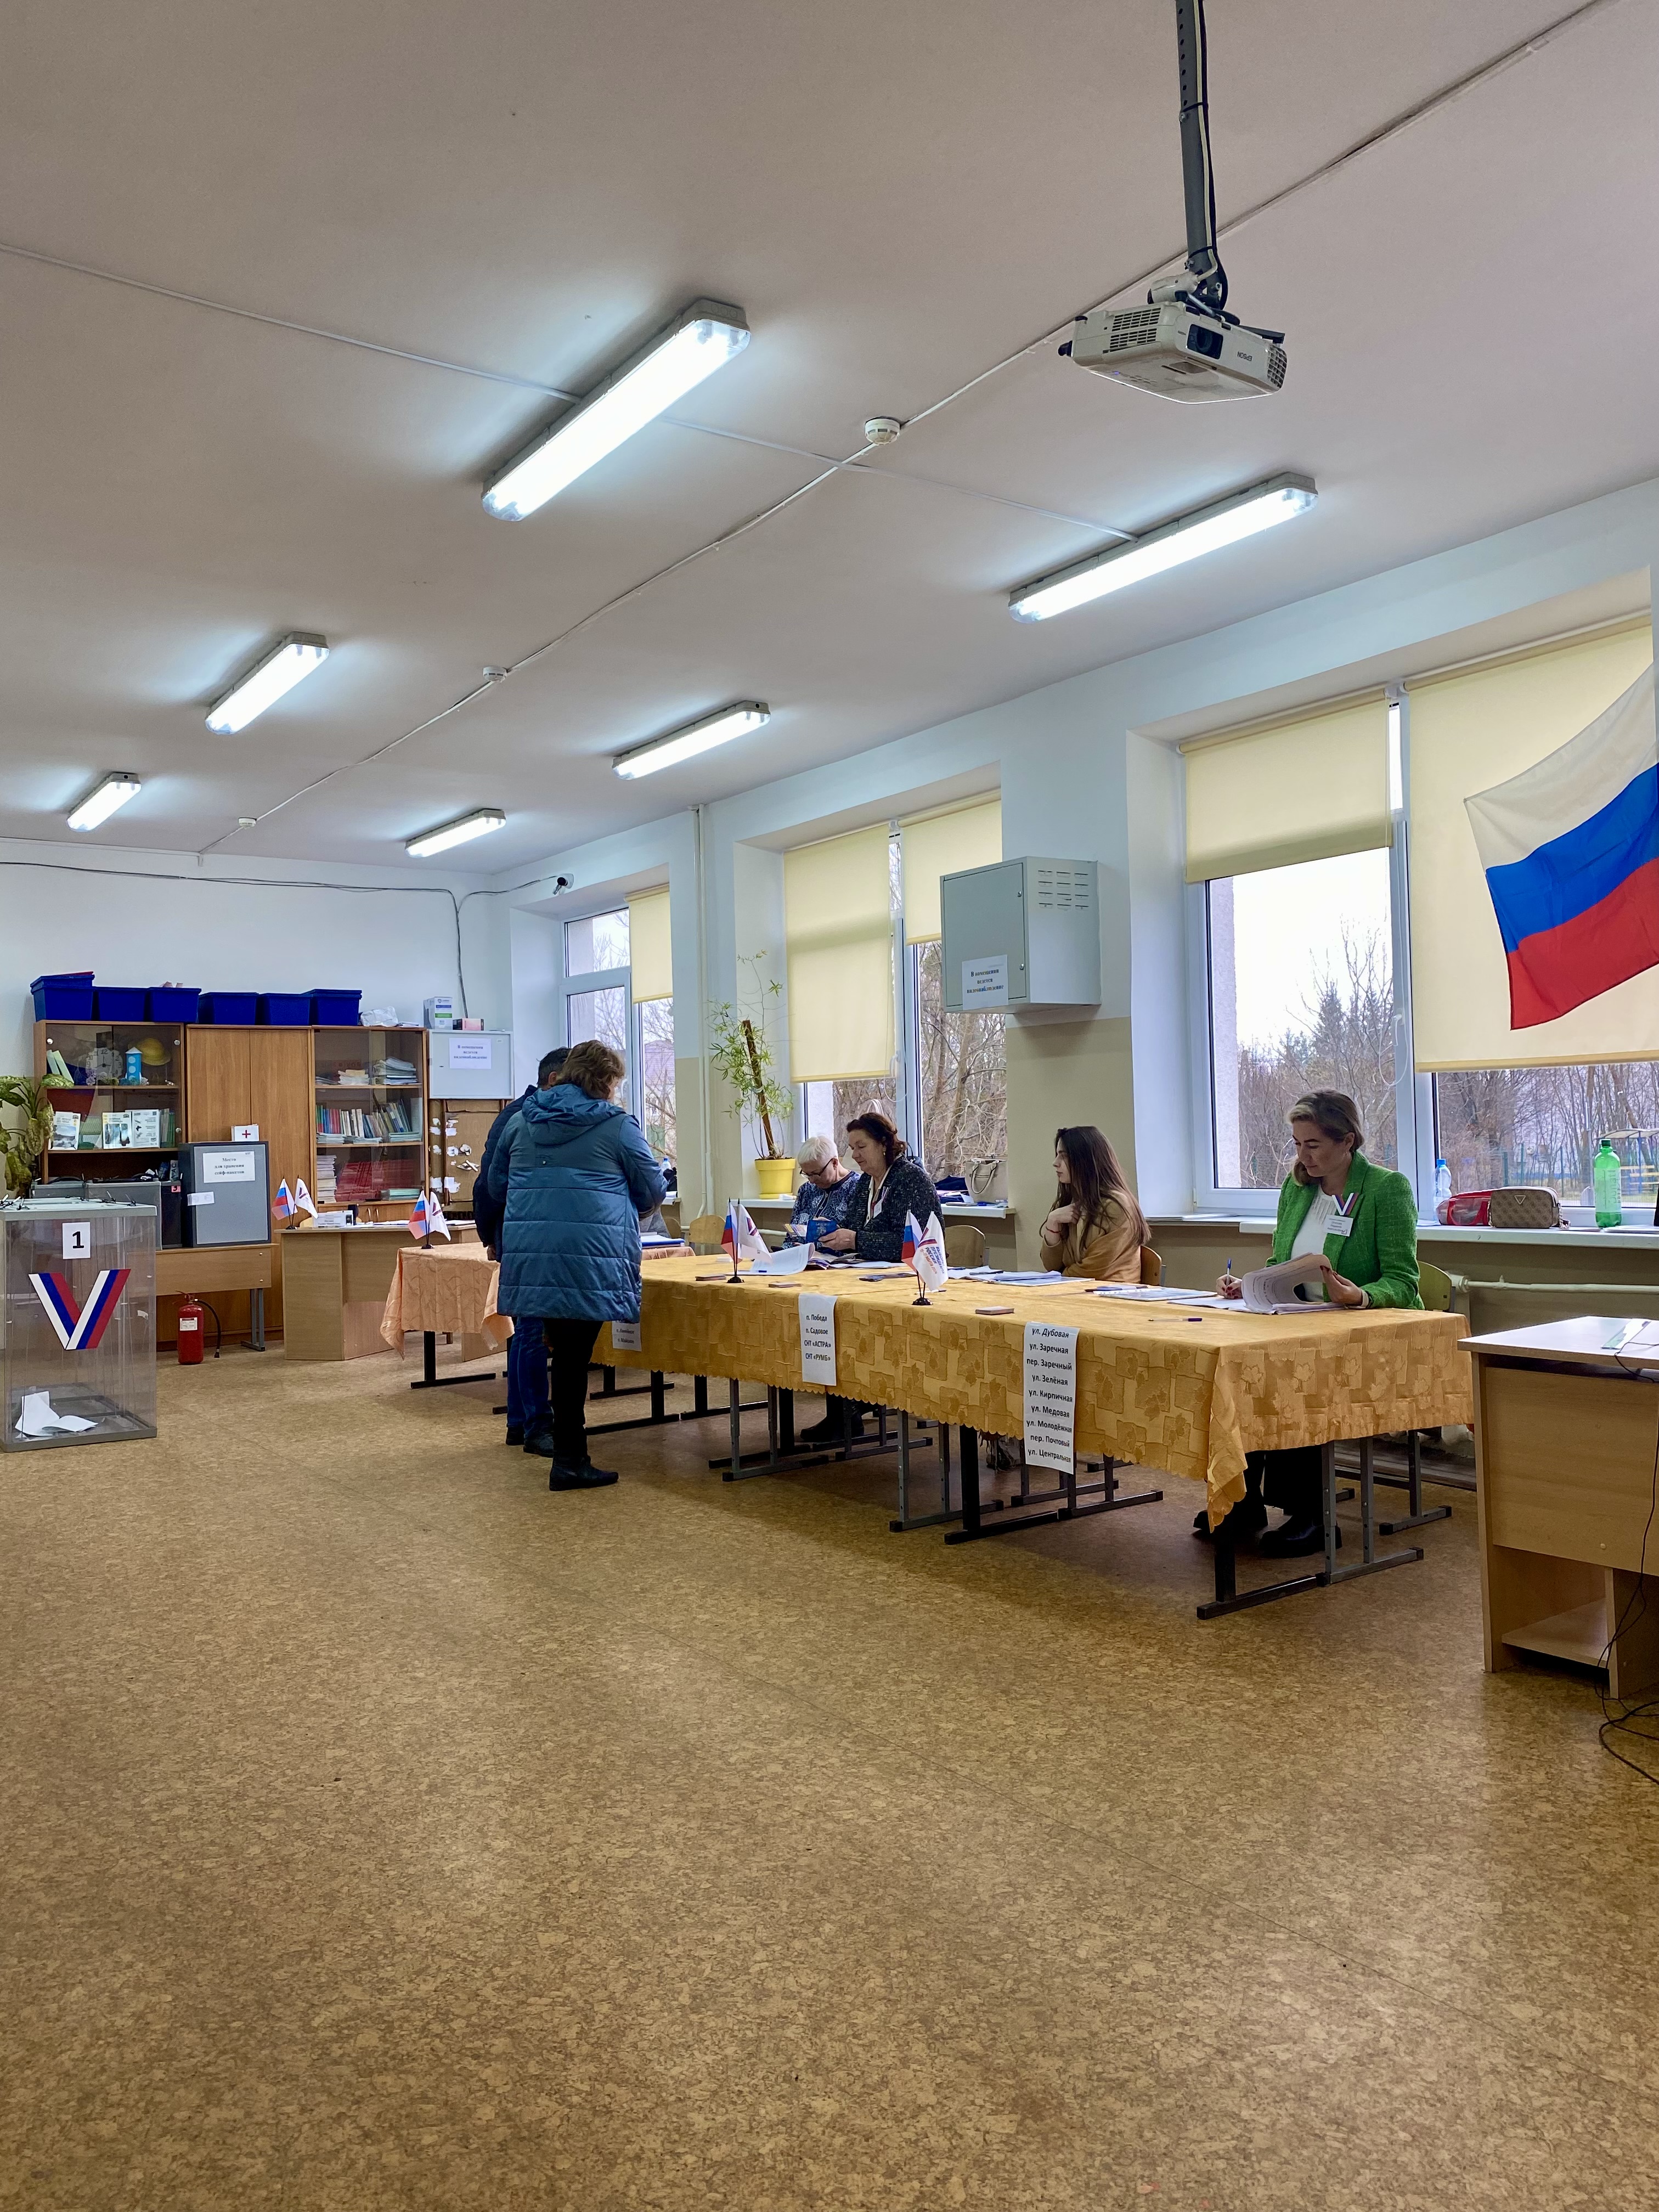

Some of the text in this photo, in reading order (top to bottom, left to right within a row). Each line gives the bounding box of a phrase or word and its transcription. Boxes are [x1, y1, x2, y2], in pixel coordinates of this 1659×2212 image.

[1237, 351, 1252, 362] EPSON
[72, 1231, 84, 1249] 1
[924, 1247, 938, 1264] РОССИИ
[811, 1314, 827, 1323] Победа
[1041, 1328, 1069, 1338] Дубовая
[1040, 1343, 1069, 1354] Заречная
[1026, 1358, 1072, 1370] пер. Заречный
[1042, 1375, 1068, 1386] Зелёная
[1040, 1390, 1073, 1402] Кирпичная
[1042, 1406, 1070, 1418] Медовая
[1037, 1420, 1073, 1433] Молодёжная
[1030, 1435, 1070, 1447] пер. Почтовый
[1039, 1449, 1071, 1463] Центральная
